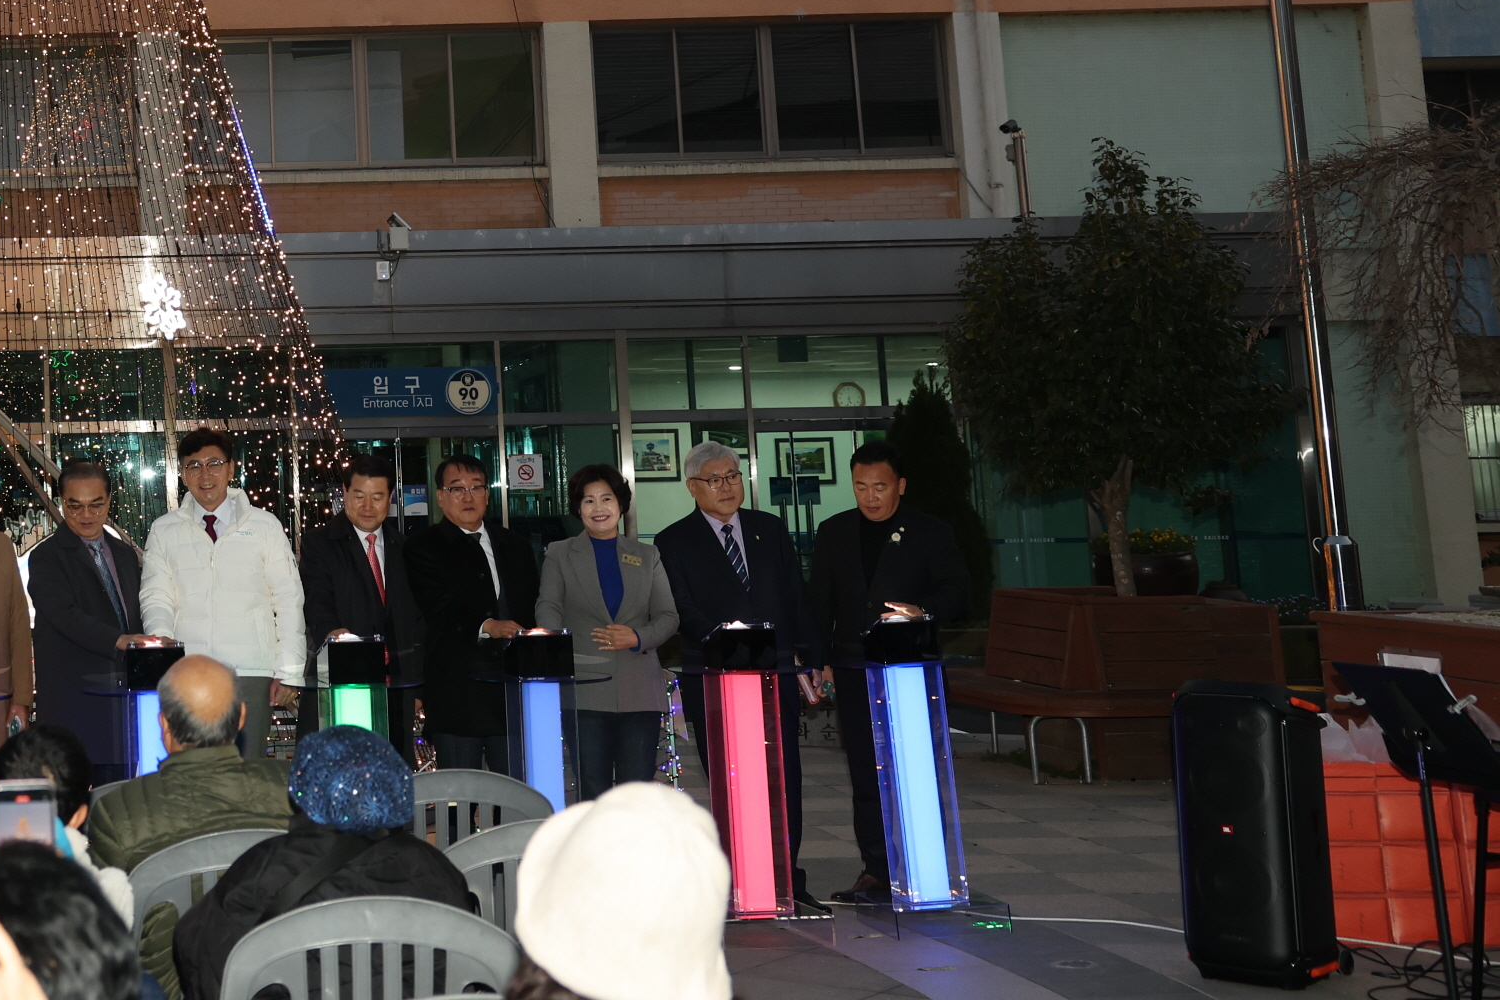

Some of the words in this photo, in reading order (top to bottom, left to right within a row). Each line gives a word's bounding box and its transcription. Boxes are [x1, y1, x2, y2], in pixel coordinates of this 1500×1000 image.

[373, 376, 420, 395] 입구
[458, 387, 479, 401] 90
[363, 398, 409, 409] Entrance
[416, 397, 433, 408] 入口
